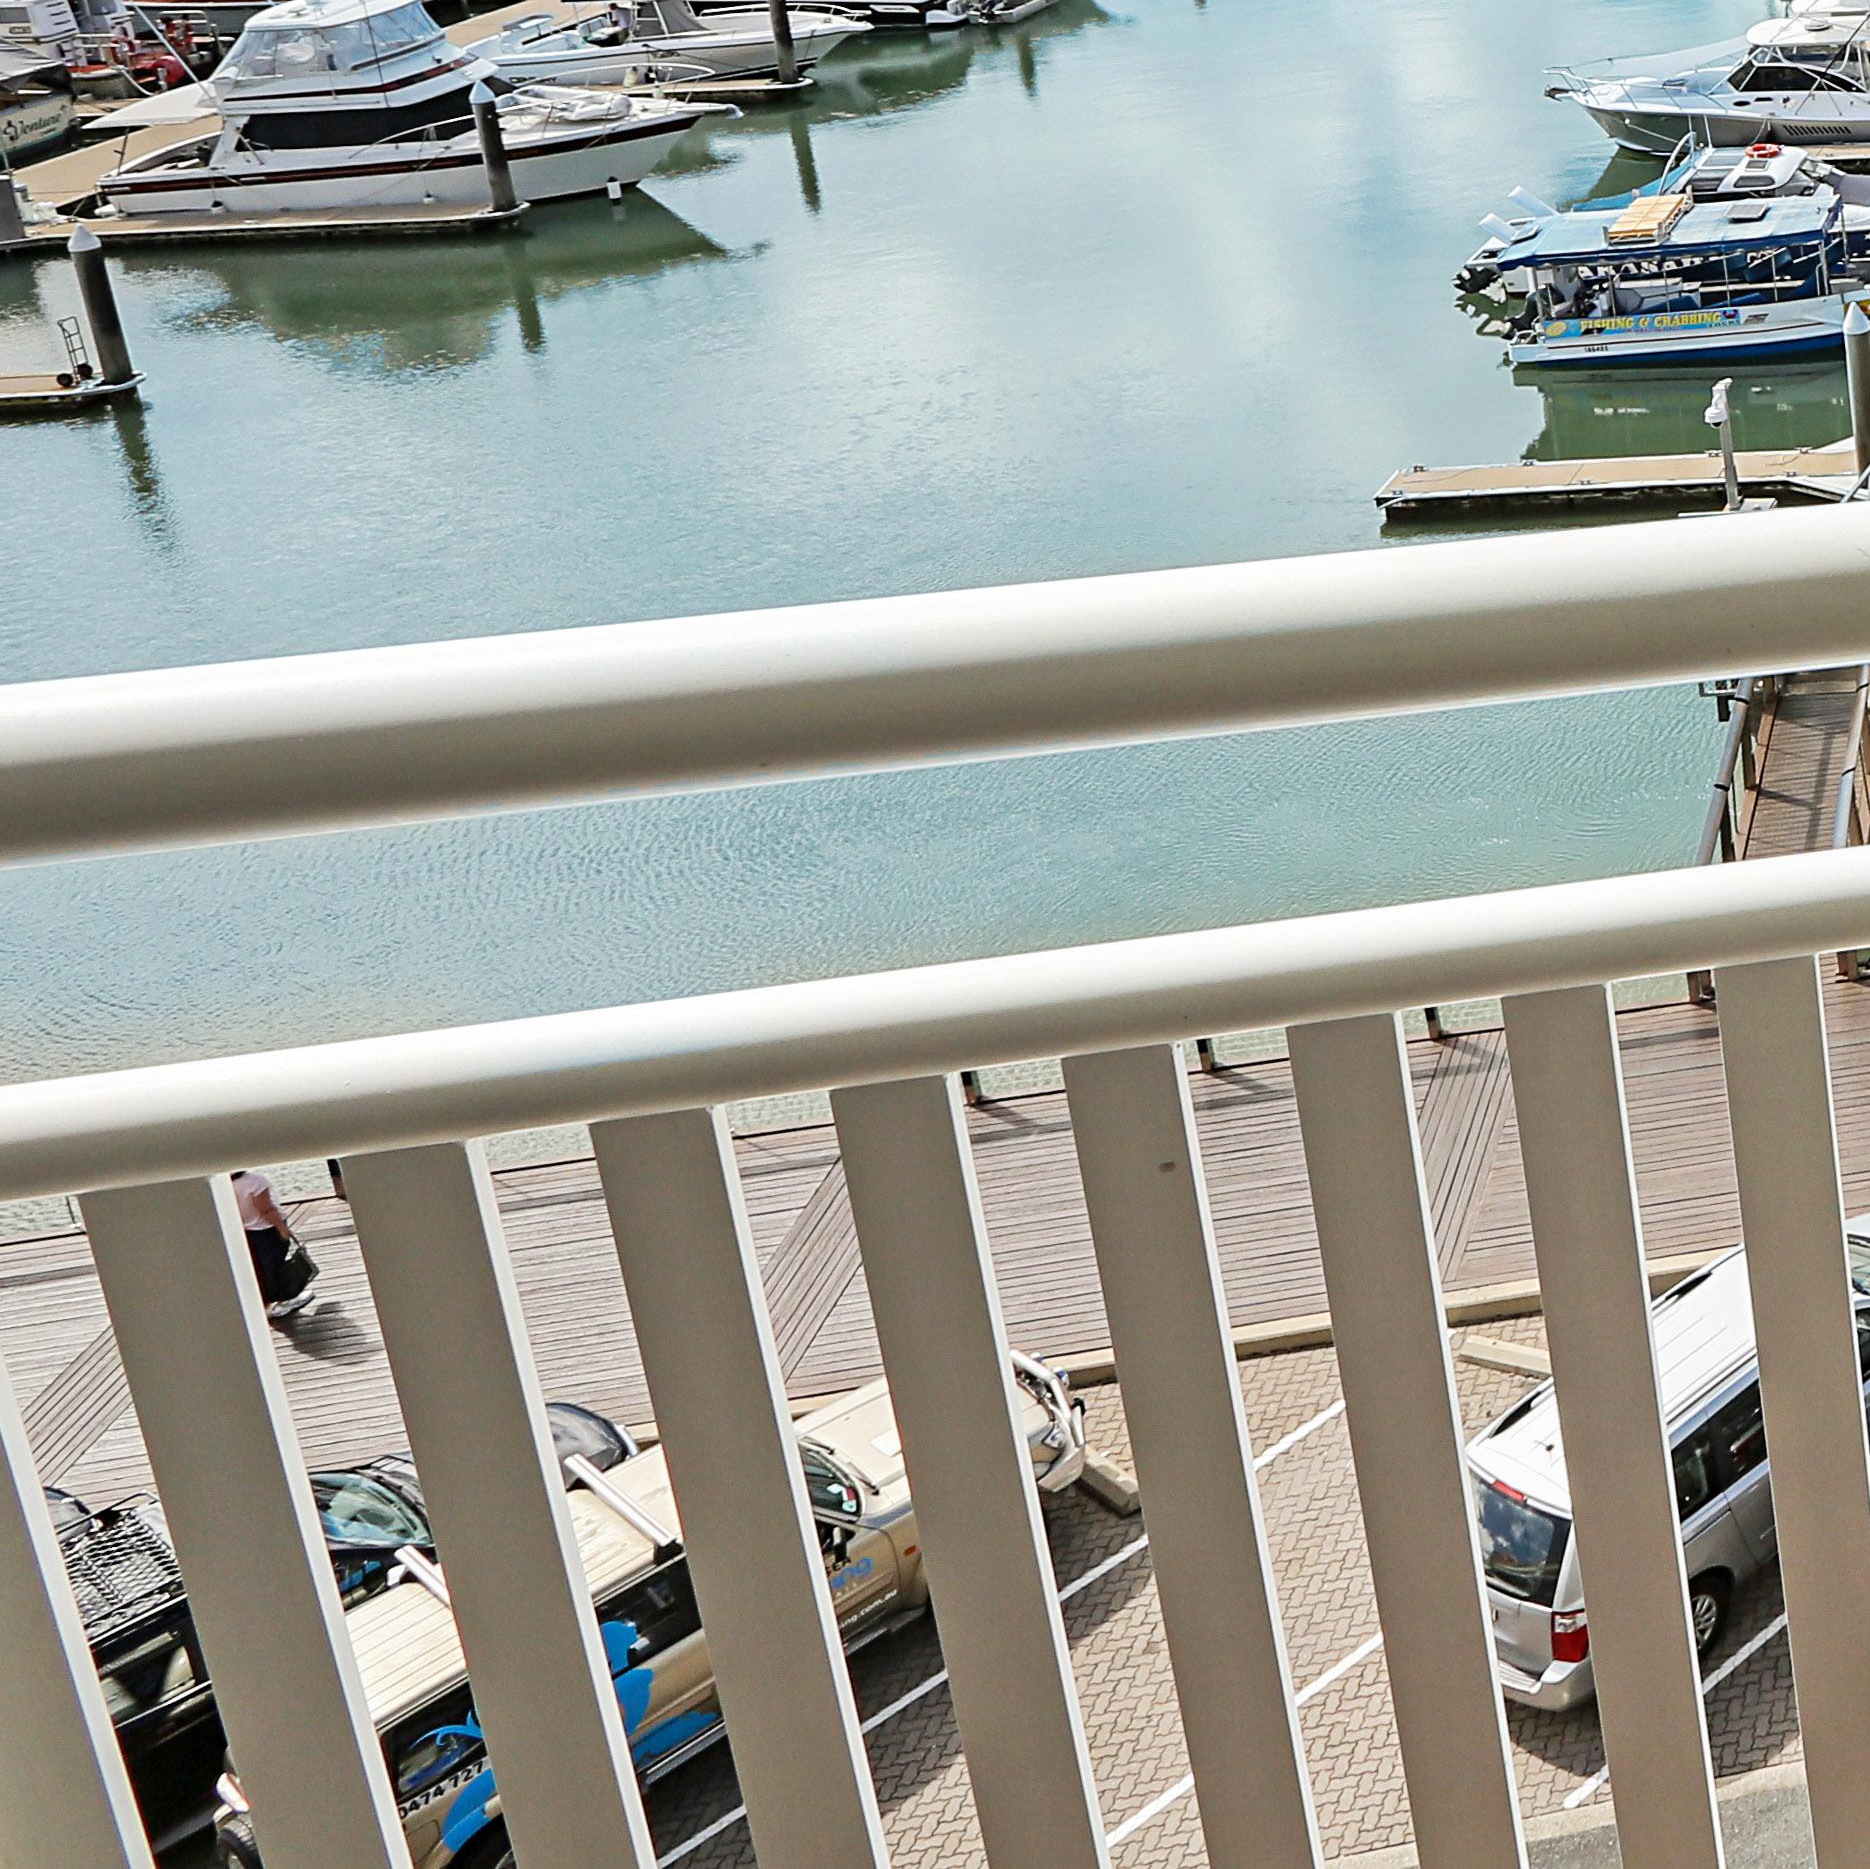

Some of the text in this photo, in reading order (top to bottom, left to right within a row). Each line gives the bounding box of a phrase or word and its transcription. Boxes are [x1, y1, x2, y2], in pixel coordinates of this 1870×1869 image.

[1580, 316, 1635, 333] FISHING
[1652, 310, 1722, 328] CRABBING
[397, 1760, 485, 1820] 0474 727
